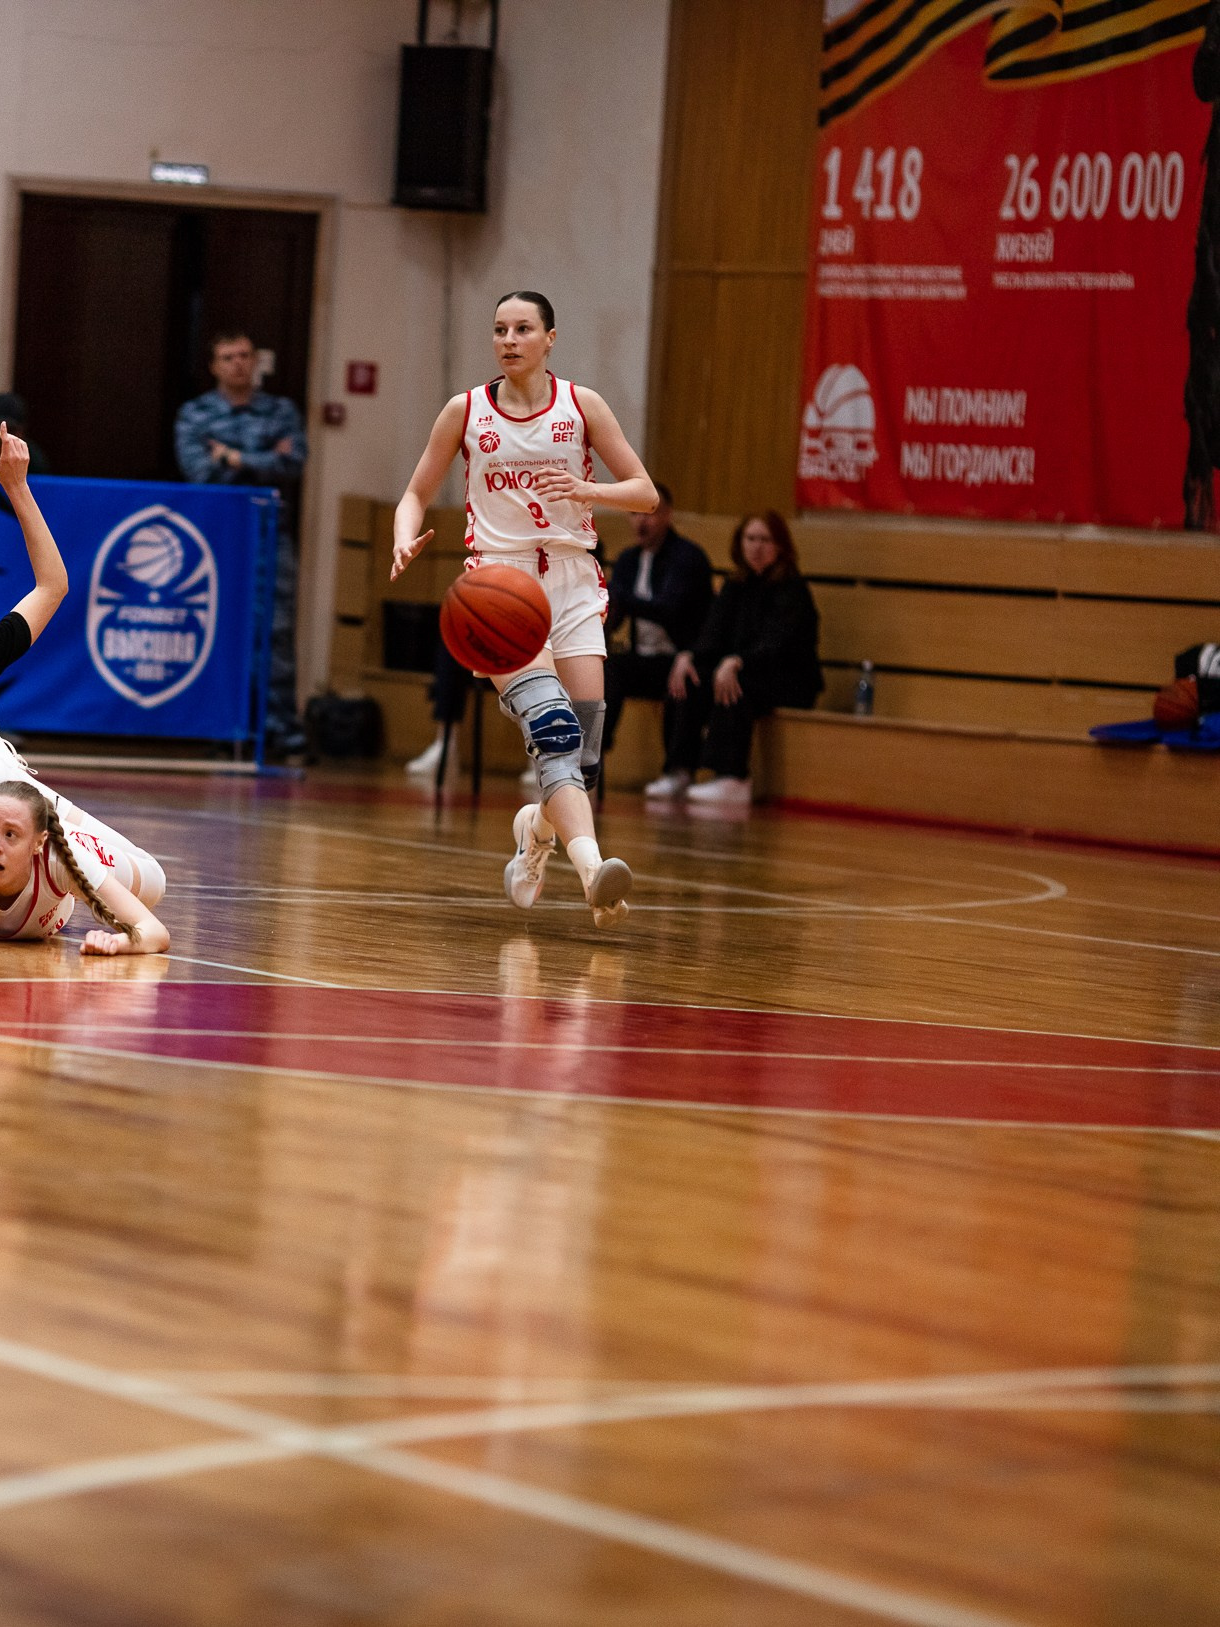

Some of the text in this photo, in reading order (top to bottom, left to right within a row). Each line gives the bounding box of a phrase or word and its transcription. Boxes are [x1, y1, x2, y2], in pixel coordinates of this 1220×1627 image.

[822, 146, 924, 222] 1 418
[999, 150, 1185, 222] 26 600 000
[551, 421, 575, 432] FON
[553, 432, 575, 443] BET
[488, 458, 568, 468] БАСКЕТБОЛЬНЫЙ КЛУБ
[527, 501, 550, 529] 9
